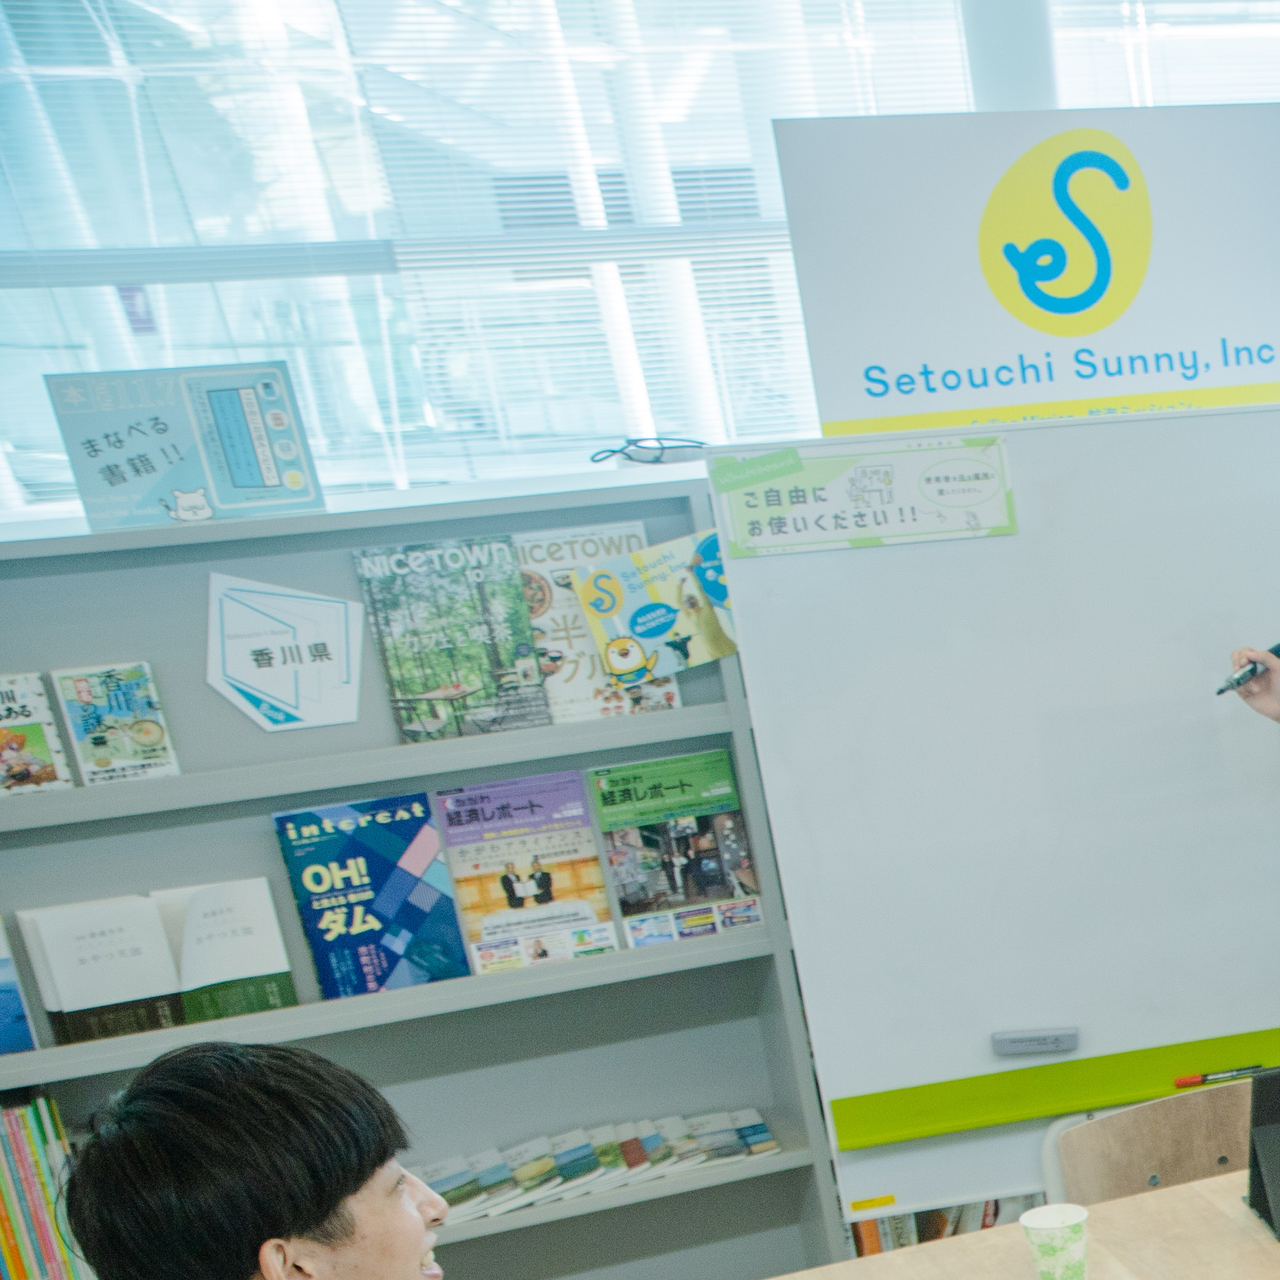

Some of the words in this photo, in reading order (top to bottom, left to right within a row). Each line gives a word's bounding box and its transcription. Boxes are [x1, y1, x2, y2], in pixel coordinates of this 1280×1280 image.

[863, 352, 1055, 398] Setouchi
[1073, 343, 1212, 381] Sunny,
[81, 415, 170, 459] まなべる
[743, 486, 828, 510] ご自由に
[747, 510, 889, 537] お使いください
[621, 551, 675, 582] Setouchi
[250, 642, 333, 669] 香川県
[601, 780, 694, 806] 経済レポート
[447, 801, 544, 827] 経済レポート
[302, 856, 370, 893] OH!
[317, 904, 383, 942] ダム
